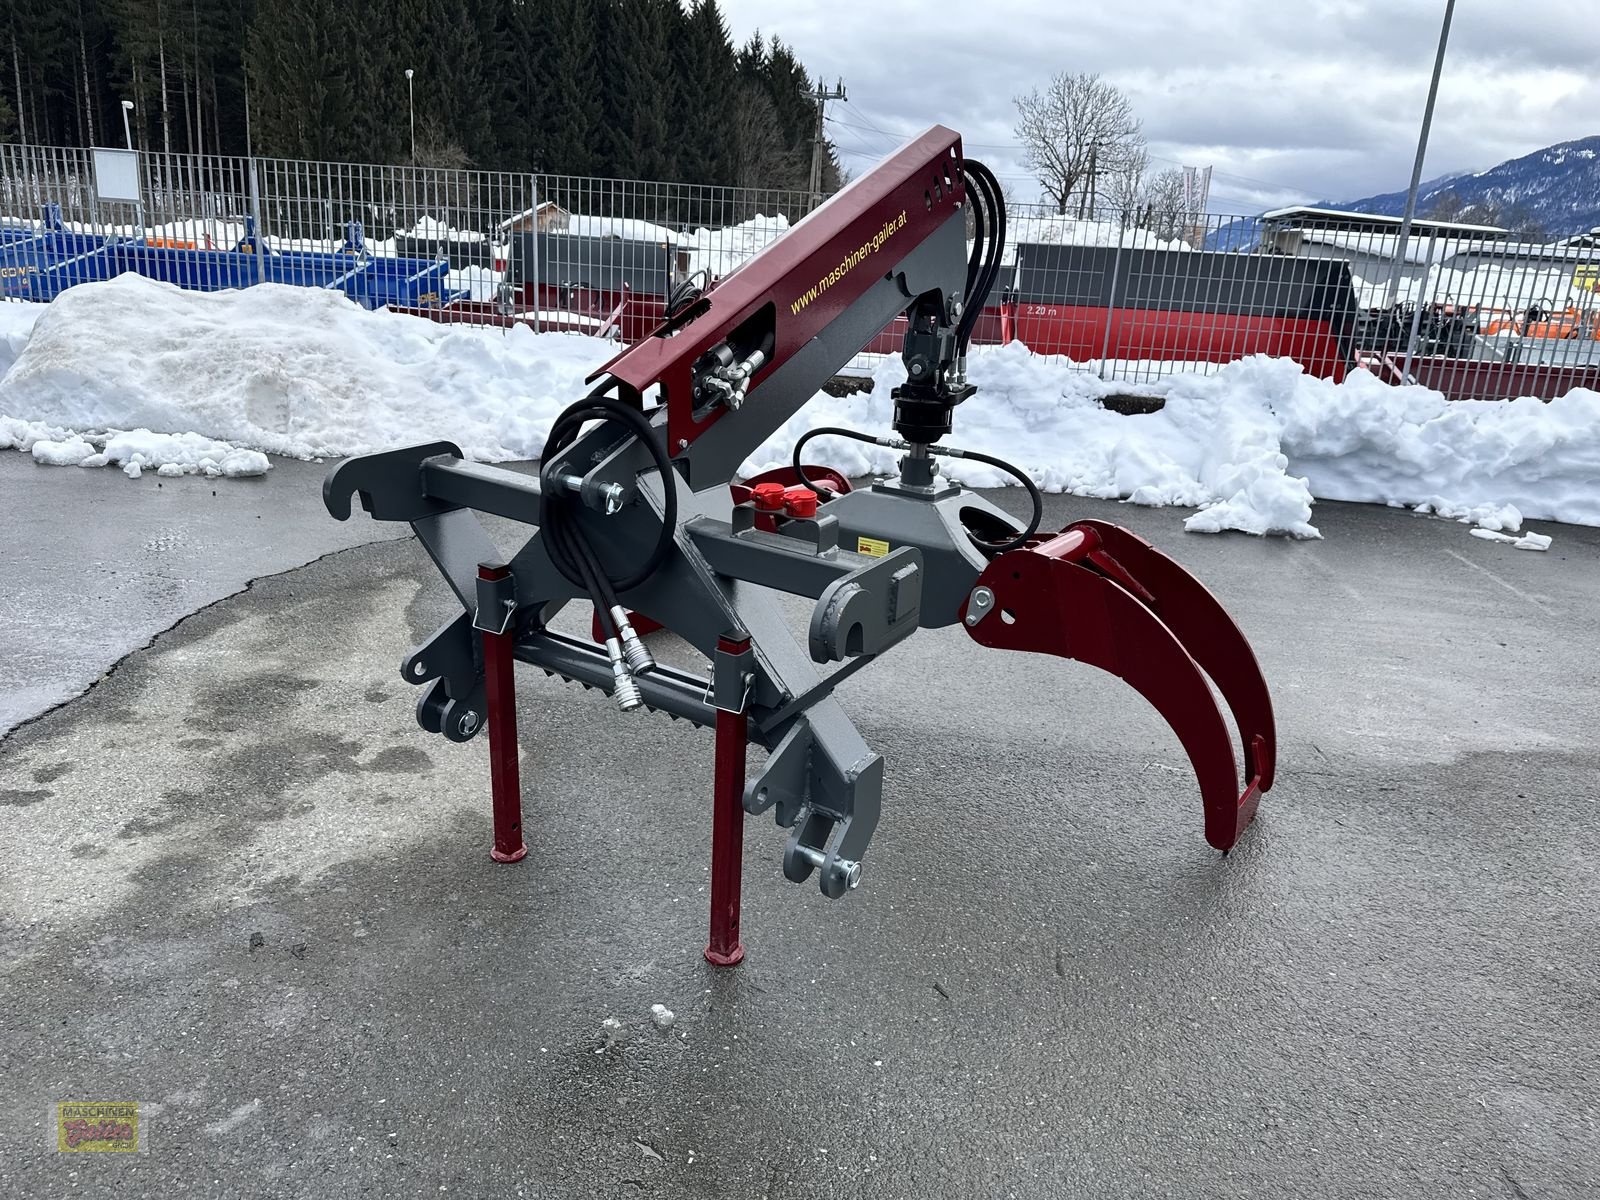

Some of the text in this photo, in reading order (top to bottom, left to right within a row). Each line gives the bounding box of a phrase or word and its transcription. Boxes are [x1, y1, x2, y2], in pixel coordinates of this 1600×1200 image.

[790, 209, 907, 315] www.maschinen-gailer.at
[1027, 305, 1057, 316] 2.20 m
